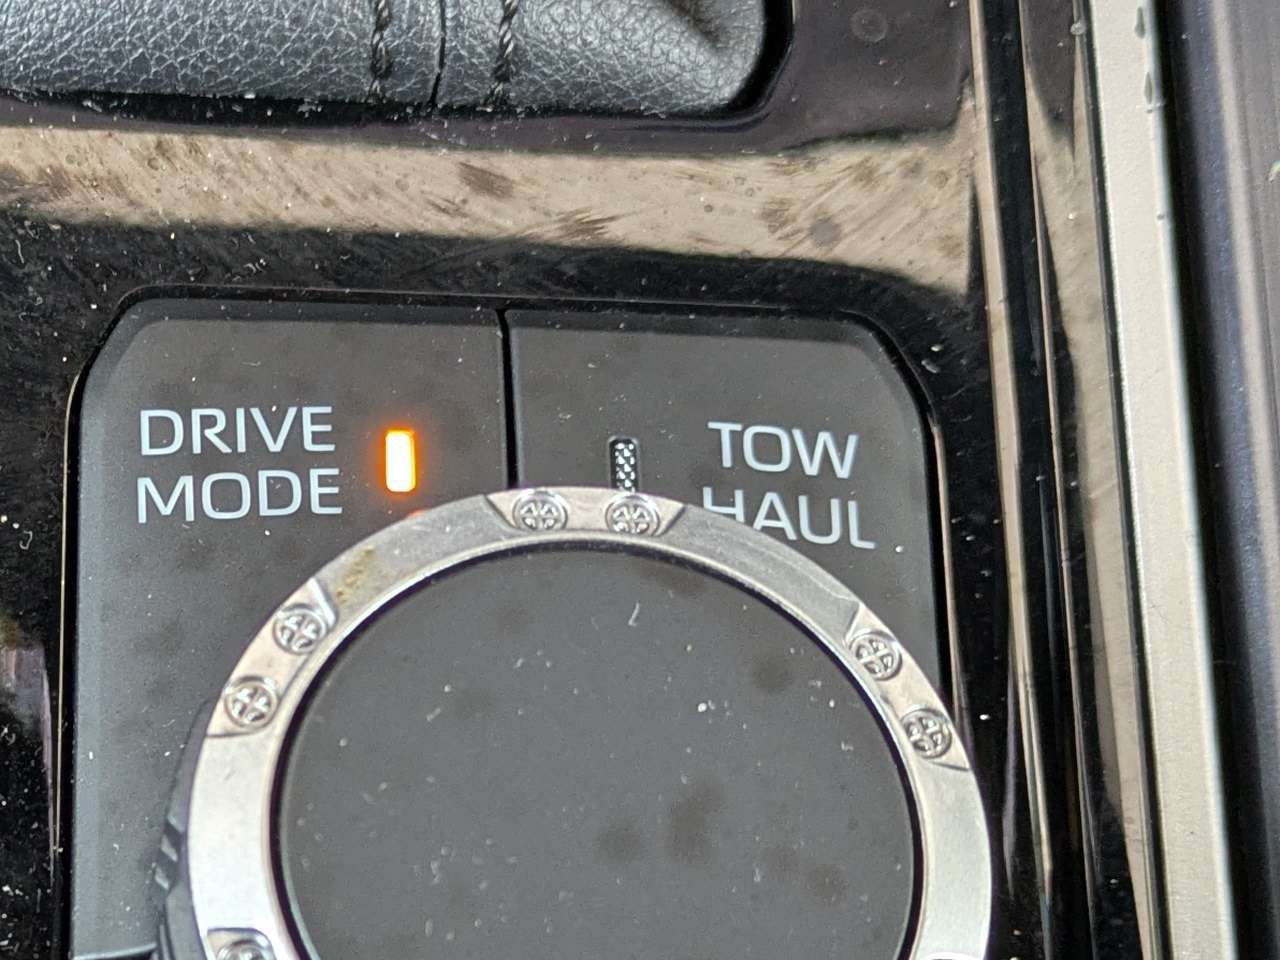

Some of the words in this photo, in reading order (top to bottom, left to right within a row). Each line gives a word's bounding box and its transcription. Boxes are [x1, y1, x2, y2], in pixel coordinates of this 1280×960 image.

[140, 406, 336, 456] DRIVE
[707, 421, 859, 479] TOW
[137, 468, 343, 524] MODE
[702, 486, 876, 550] HAUL
